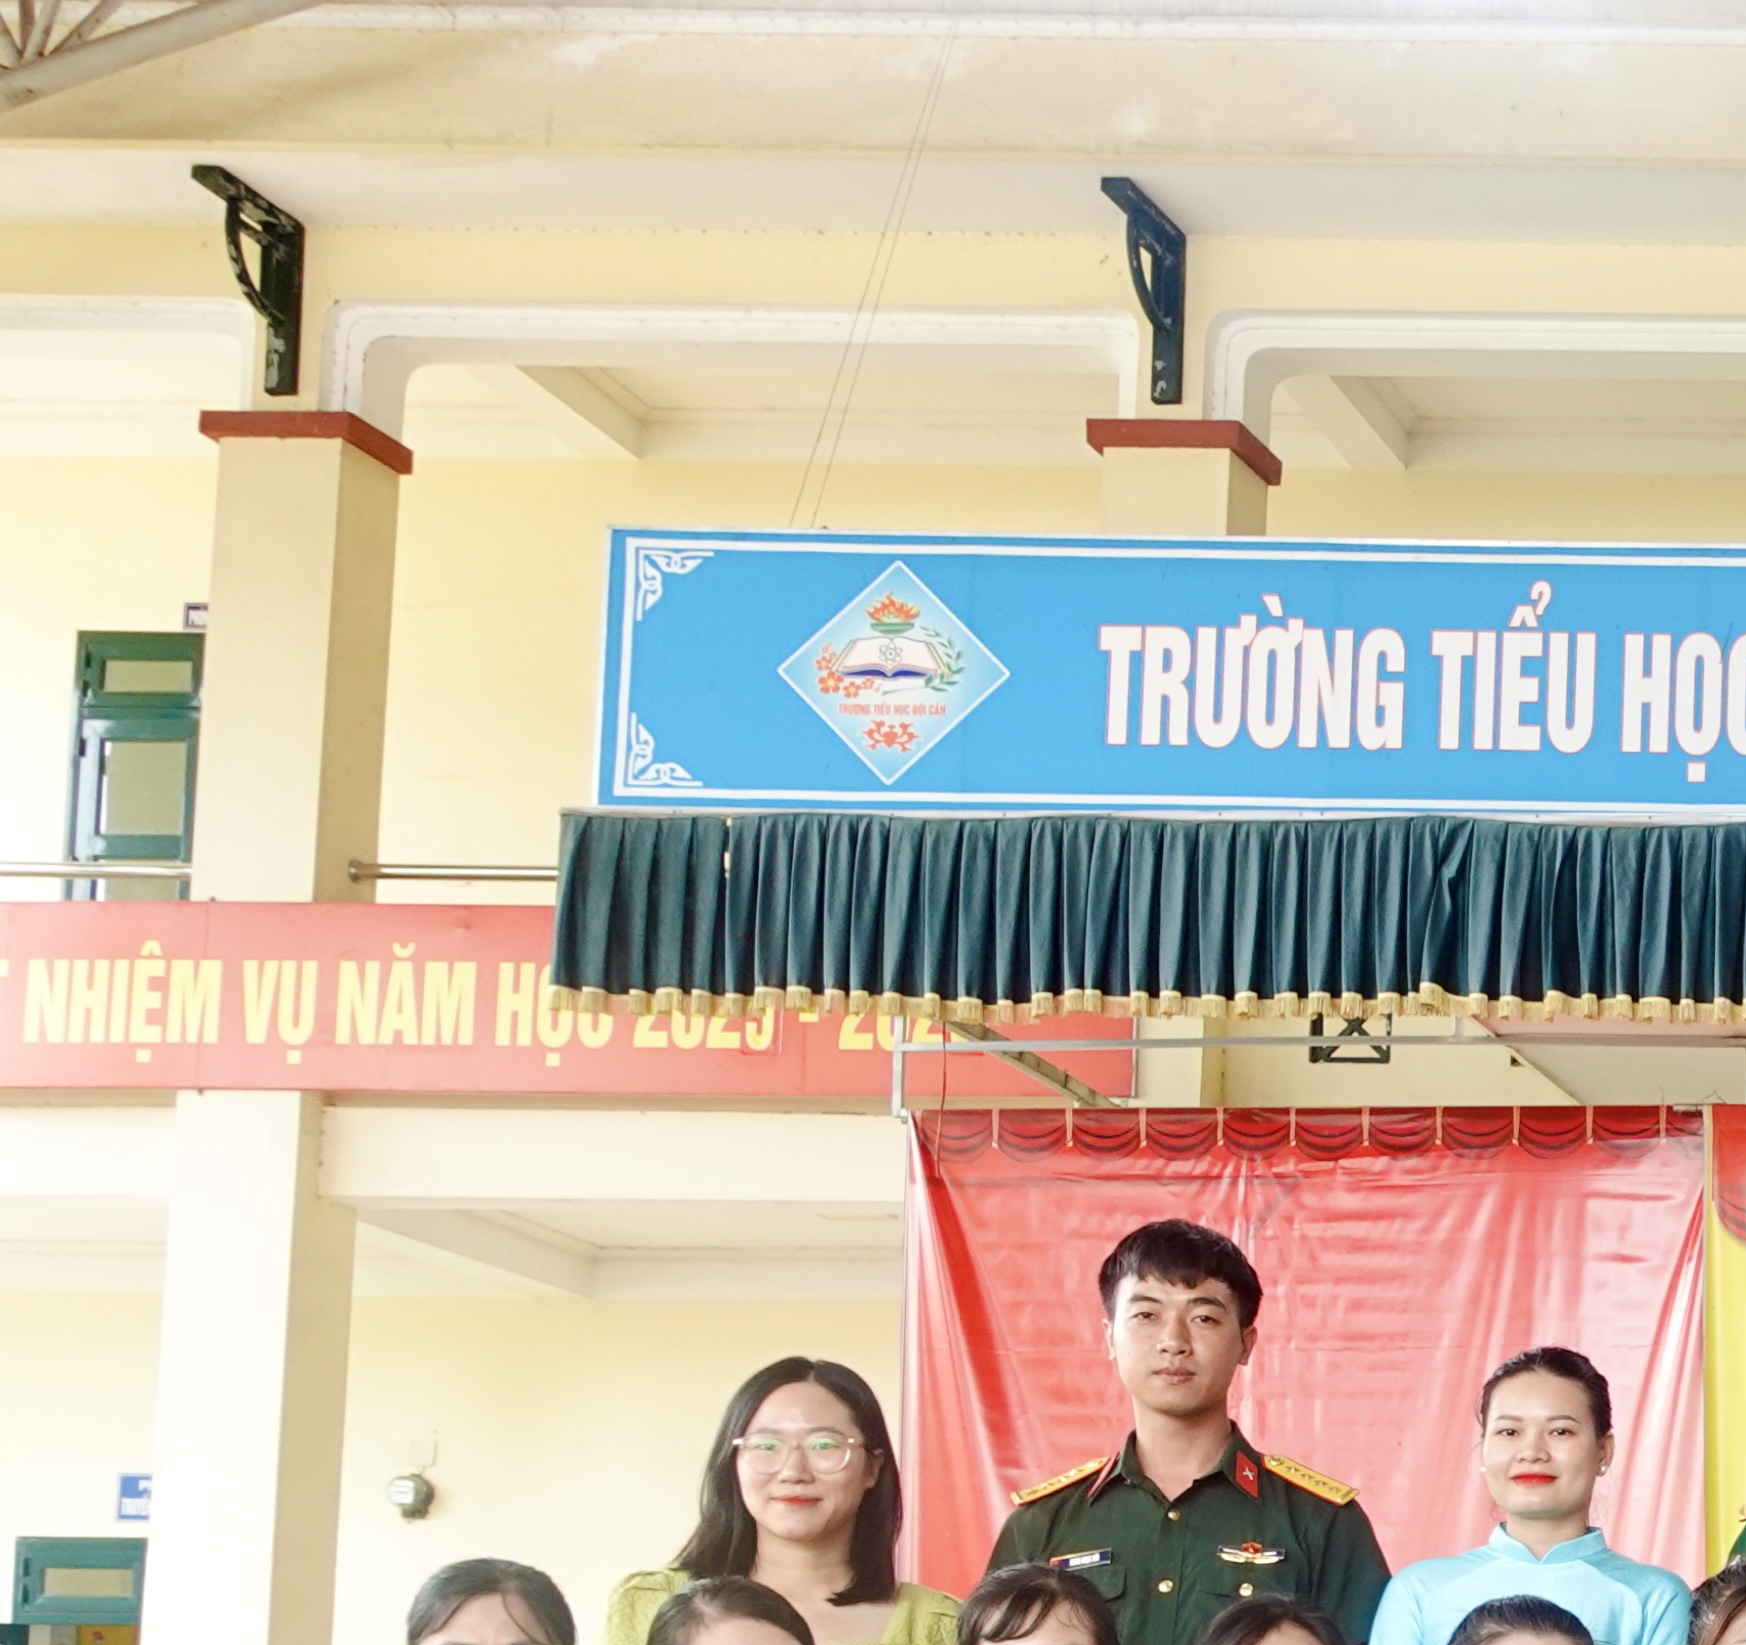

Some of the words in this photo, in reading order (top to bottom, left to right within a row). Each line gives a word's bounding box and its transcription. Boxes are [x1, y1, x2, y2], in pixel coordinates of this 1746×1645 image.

[1098, 593, 1406, 751] TRƯỜNG
[1431, 579, 1597, 754] TIỂU
[23, 940, 222, 1064] NHIỆM
[242, 959, 319, 1065] VỤ
[335, 942, 476, 1047] NĂM
